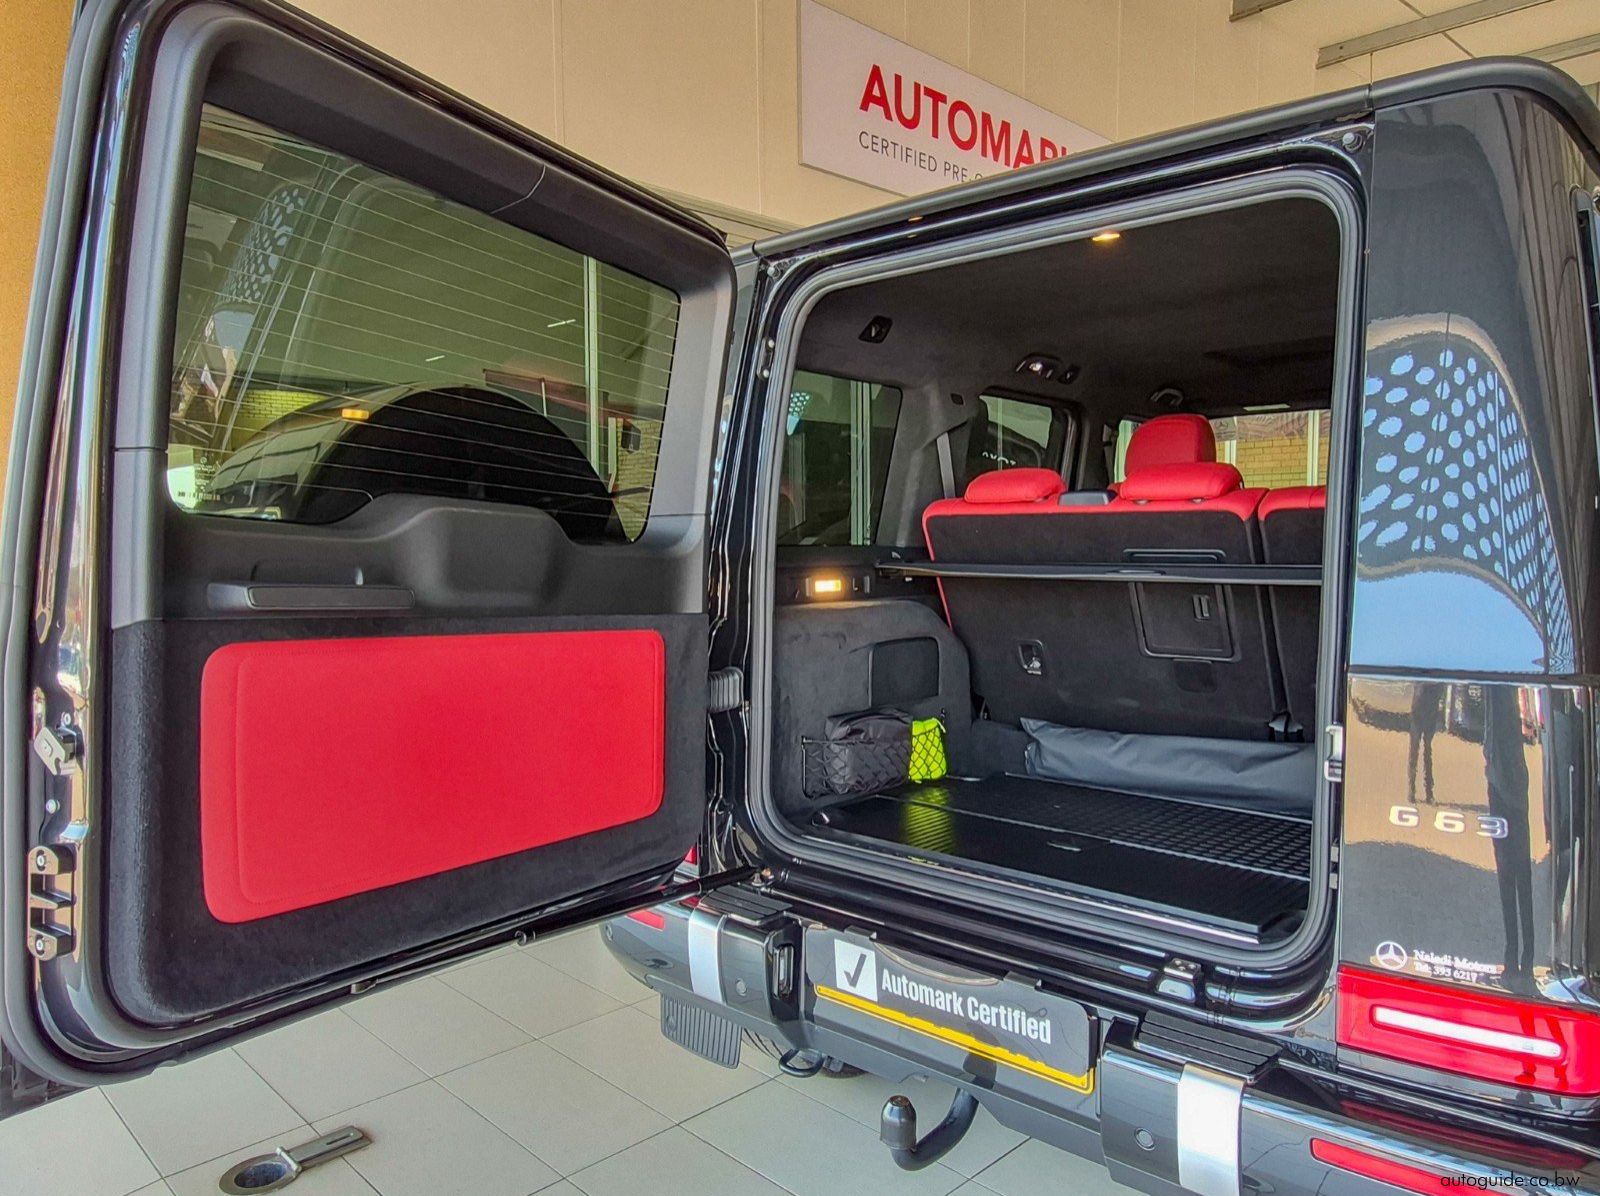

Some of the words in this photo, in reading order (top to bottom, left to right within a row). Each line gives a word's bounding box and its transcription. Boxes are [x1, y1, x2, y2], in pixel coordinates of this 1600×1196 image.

[858, 130, 938, 173] CERTIFIED
[882, 968, 965, 1018] Automark
[967, 996, 1051, 1045] Certified
